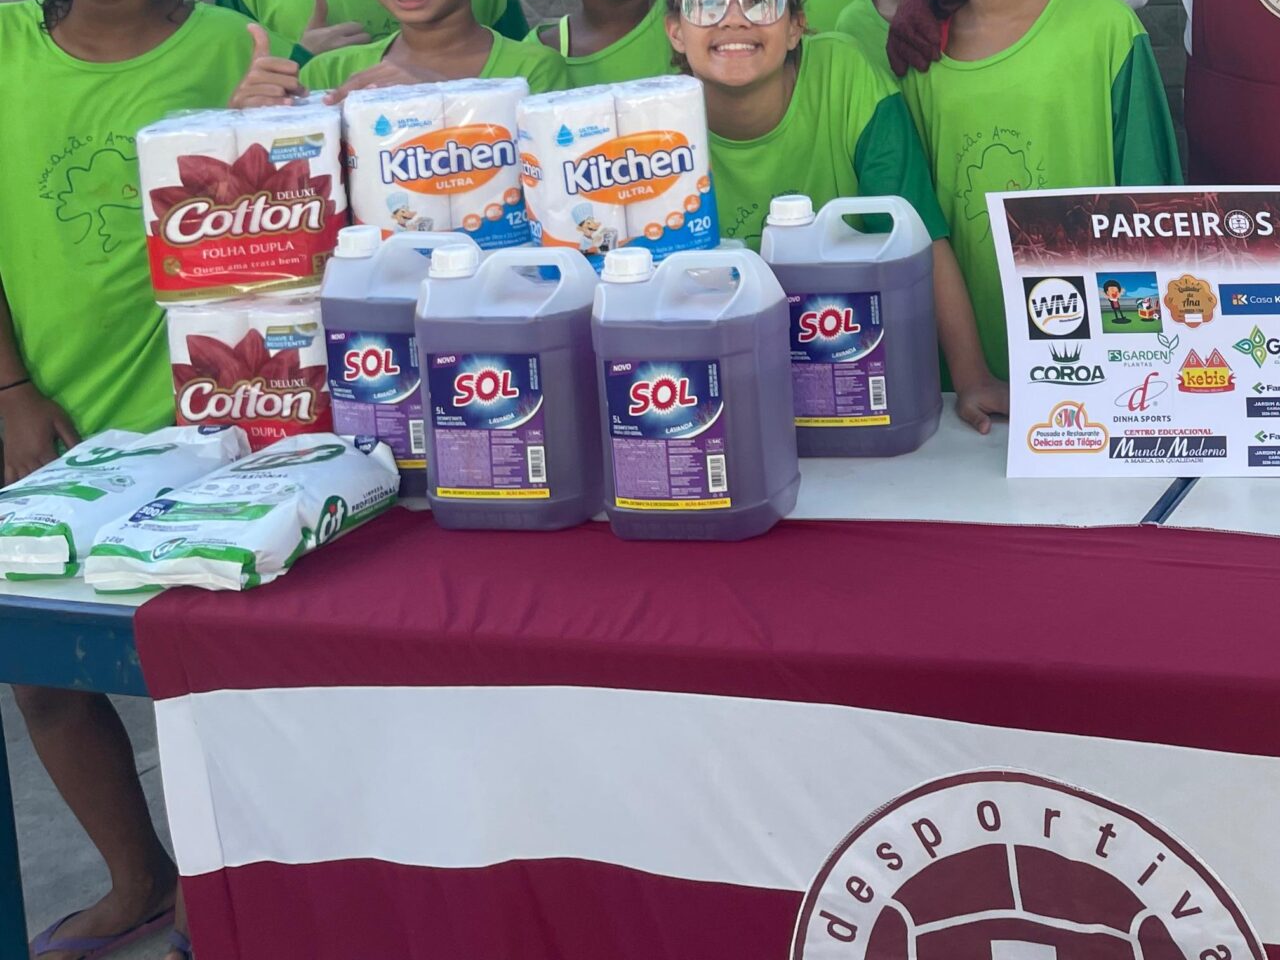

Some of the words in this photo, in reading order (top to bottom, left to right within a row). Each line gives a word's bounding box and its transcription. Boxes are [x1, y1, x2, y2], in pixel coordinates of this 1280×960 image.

[105, 130, 137, 145] Amo
[380, 139, 517, 185] Kitchen
[563, 145, 694, 195] Kitchen
[435, 177, 474, 190] ULTRA
[277, 187, 316, 200] DELUXE
[618, 186, 654, 200] ULTRA
[163, 195, 322, 244] Cotton
[687, 216, 711, 233] 120
[1091, 209, 1274, 239] PARCEIROS
[202, 241, 246, 260] FOLHA
[250, 240, 295, 254] DUPLA
[193, 263, 225, 275] Quem
[227, 261, 249, 271] ama
[251, 258, 277, 269] trata
[278, 256, 300, 266] bem
[1031, 292, 1078, 319] WM
[1249, 295, 1273, 304] Casa
[798, 304, 861, 343] SOL
[437, 356, 456, 365] NOVO
[1122, 349, 1169, 361] GARDEN
[344, 346, 400, 382] SOL
[613, 363, 632, 372] NOVO
[1029, 365, 1105, 382] COROA
[1186, 370, 1226, 385] kebis
[270, 378, 307, 389] DELUXE
[453, 366, 519, 407] SOL
[179, 381, 312, 421] Cotton
[628, 373, 698, 417] SOL
[435, 406, 446, 415] 5L
[488, 412, 515, 425] LAVANDA
[612, 415, 622, 424] 5L
[665, 421, 694, 434] LAVANDA
[251, 426, 287, 438] DUPLA
[1064, 438, 1074, 446] da
[1112, 437, 1165, 458] Mundo
[1167, 436, 1226, 458] Moderno
[351, 486, 397, 513] PROFISSIONAL
